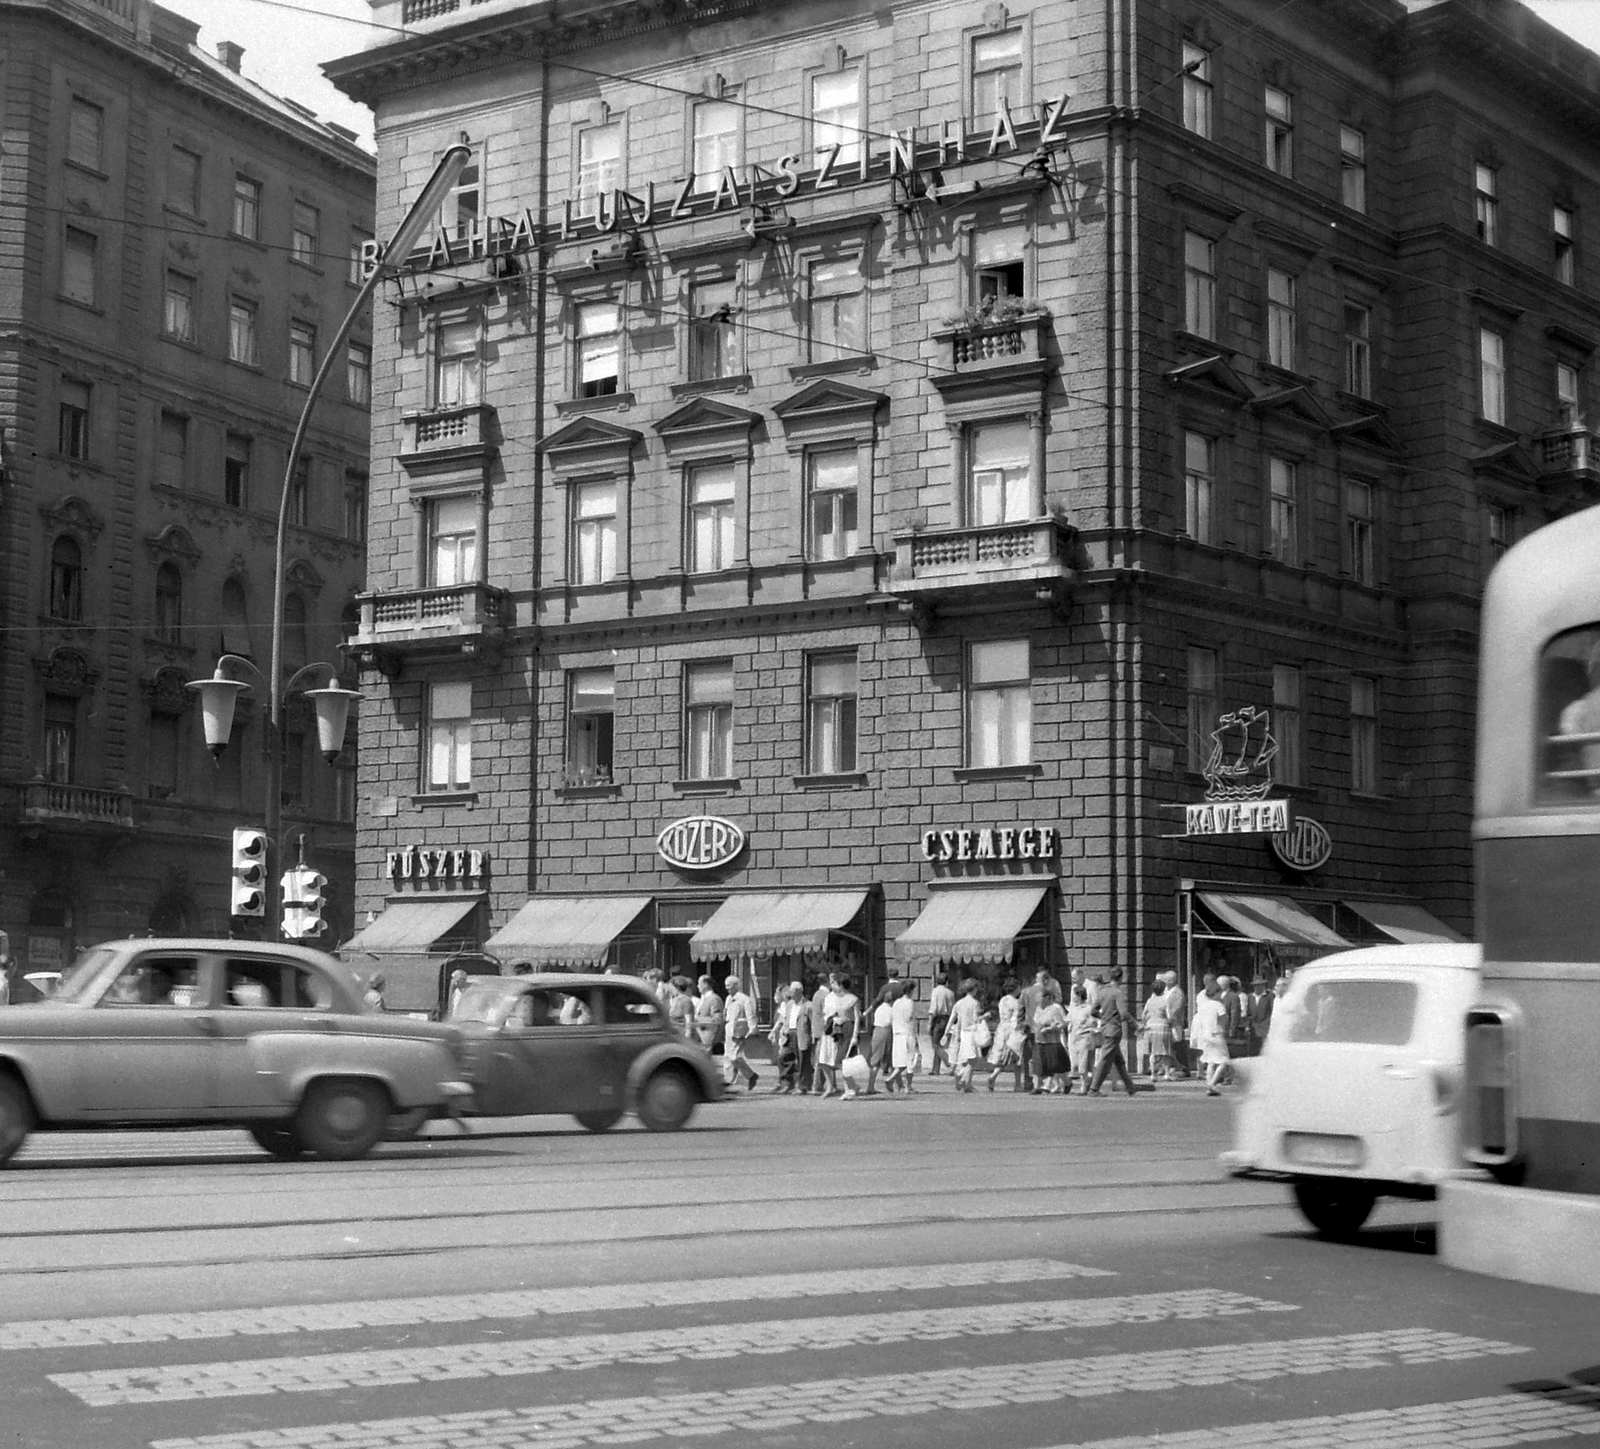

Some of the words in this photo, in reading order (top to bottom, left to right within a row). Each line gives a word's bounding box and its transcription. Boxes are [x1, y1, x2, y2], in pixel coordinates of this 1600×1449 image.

[362, 208, 535, 279] BAHA
[562, 166, 740, 239] LUJZA
[922, 827, 1054, 861] CSEMEGE
